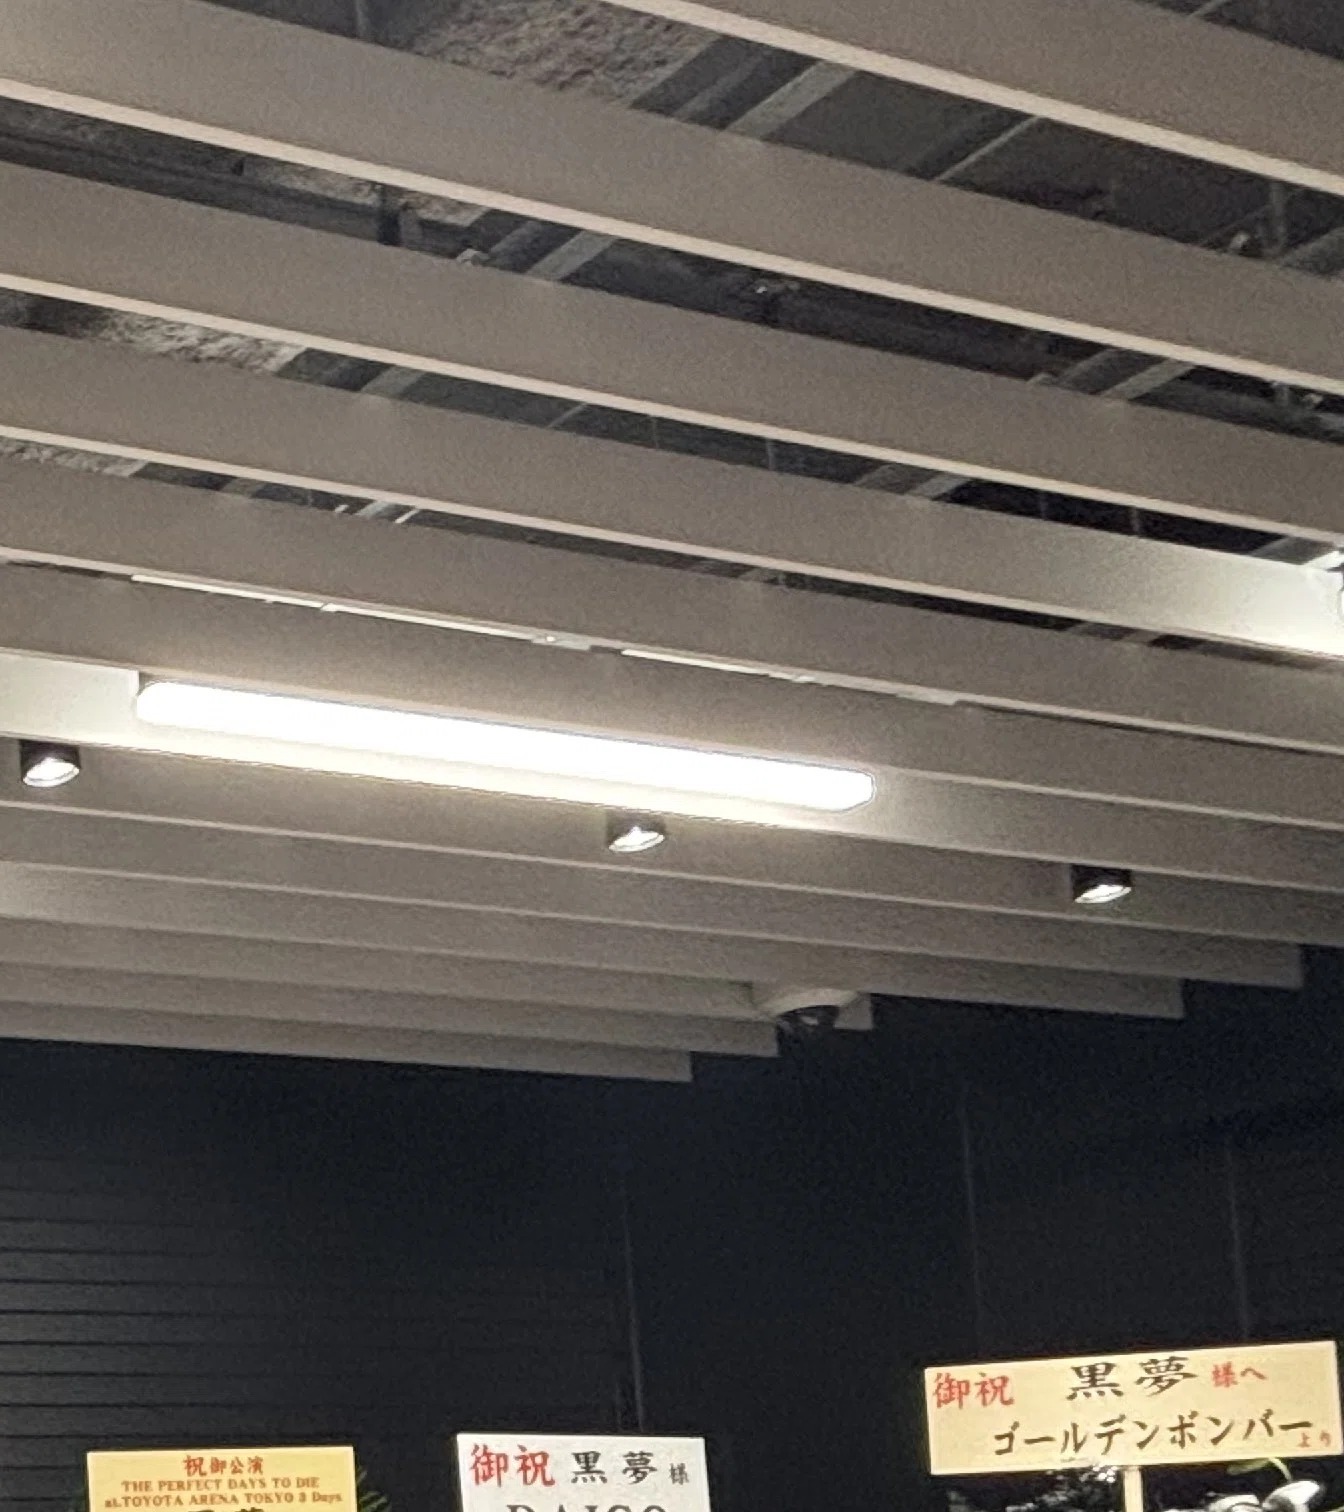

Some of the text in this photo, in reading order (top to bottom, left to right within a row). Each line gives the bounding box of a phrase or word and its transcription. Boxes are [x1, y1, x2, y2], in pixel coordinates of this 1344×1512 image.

[932, 1371, 1016, 1410] 御祝
[993, 1408, 1313, 1456] ゴールデンボンバー
[121, 1477, 320, 1492] THE PERFECT DAYS TO DIE
[469, 1443, 556, 1488] 御祝
[189, 1493, 239, 1505] ARENA
[244, 1492, 294, 1504] TOKYO
[312, 1491, 342, 1505] Days
